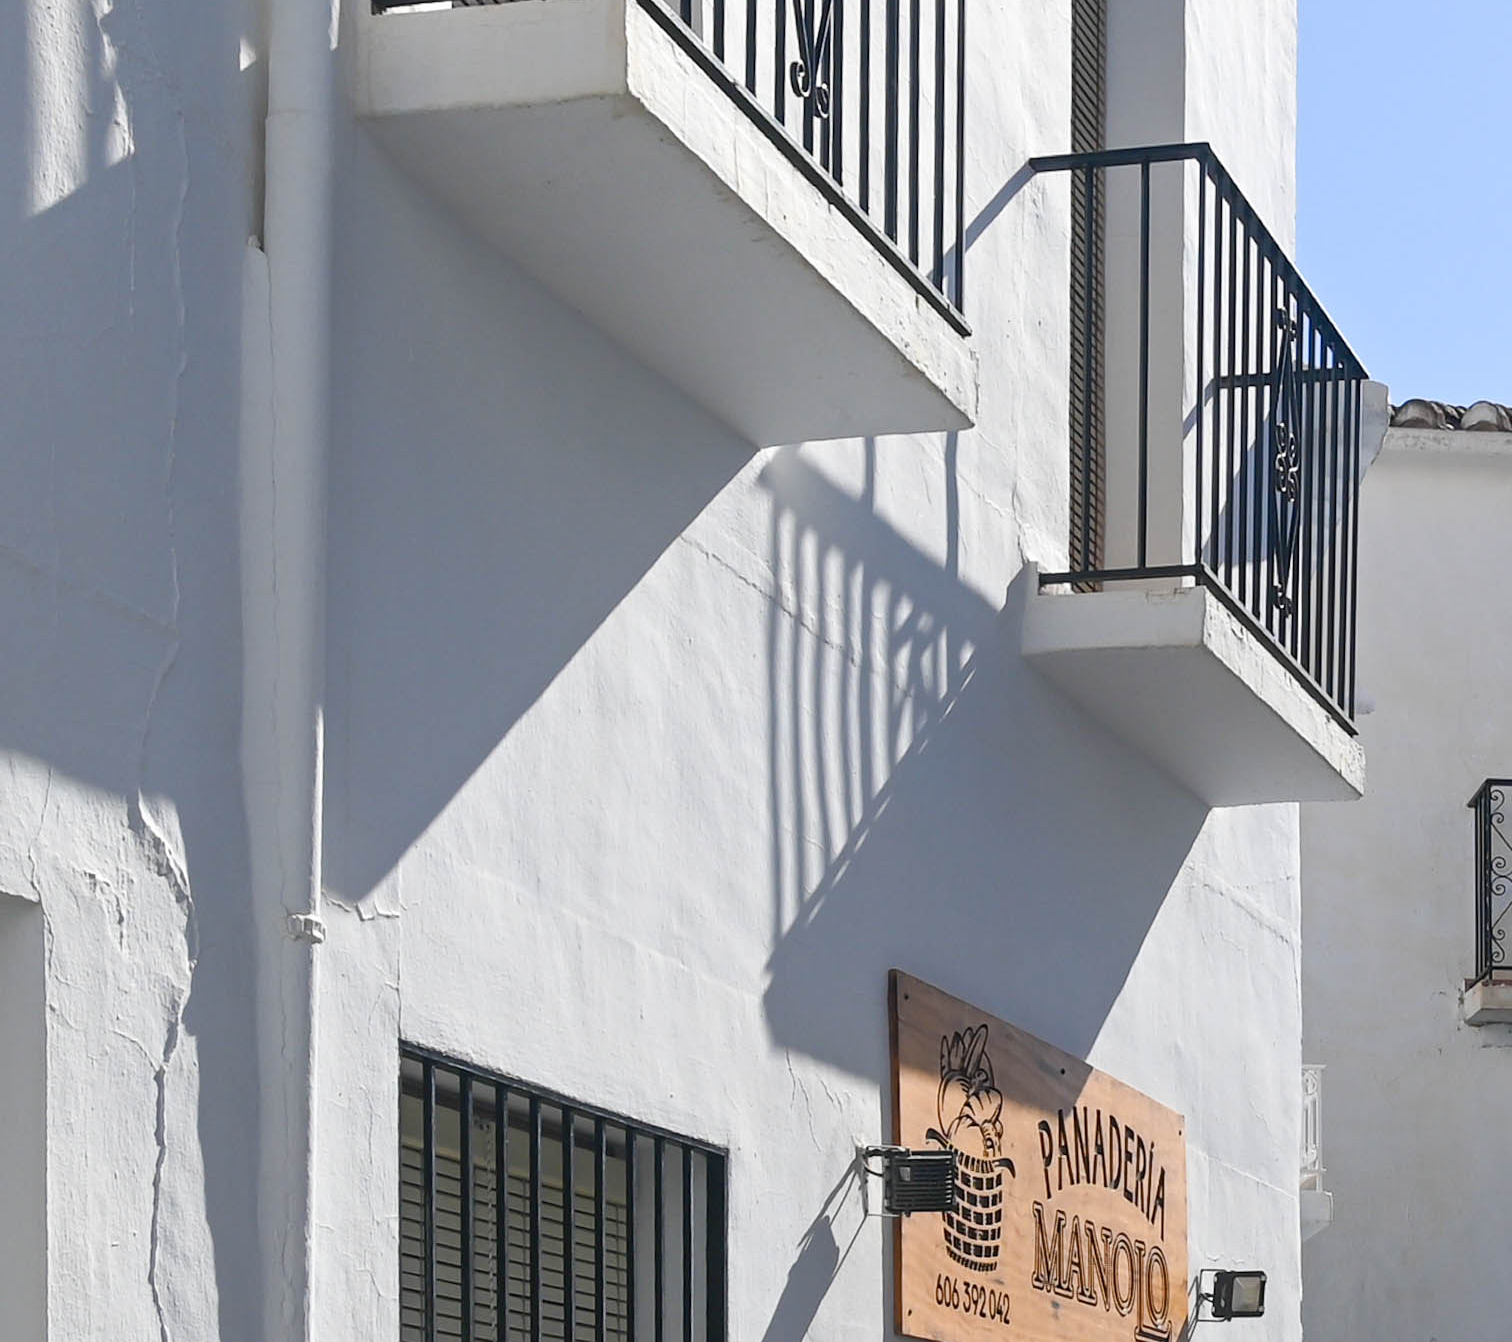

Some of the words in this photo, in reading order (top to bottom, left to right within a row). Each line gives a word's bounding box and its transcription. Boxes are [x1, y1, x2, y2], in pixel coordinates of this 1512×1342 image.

[1038, 1106, 1165, 1241] PANADERÍA
[936, 1273, 960, 1310] 606
[963, 1280, 987, 1318] 392
[989, 1288, 1010, 1325] 042
